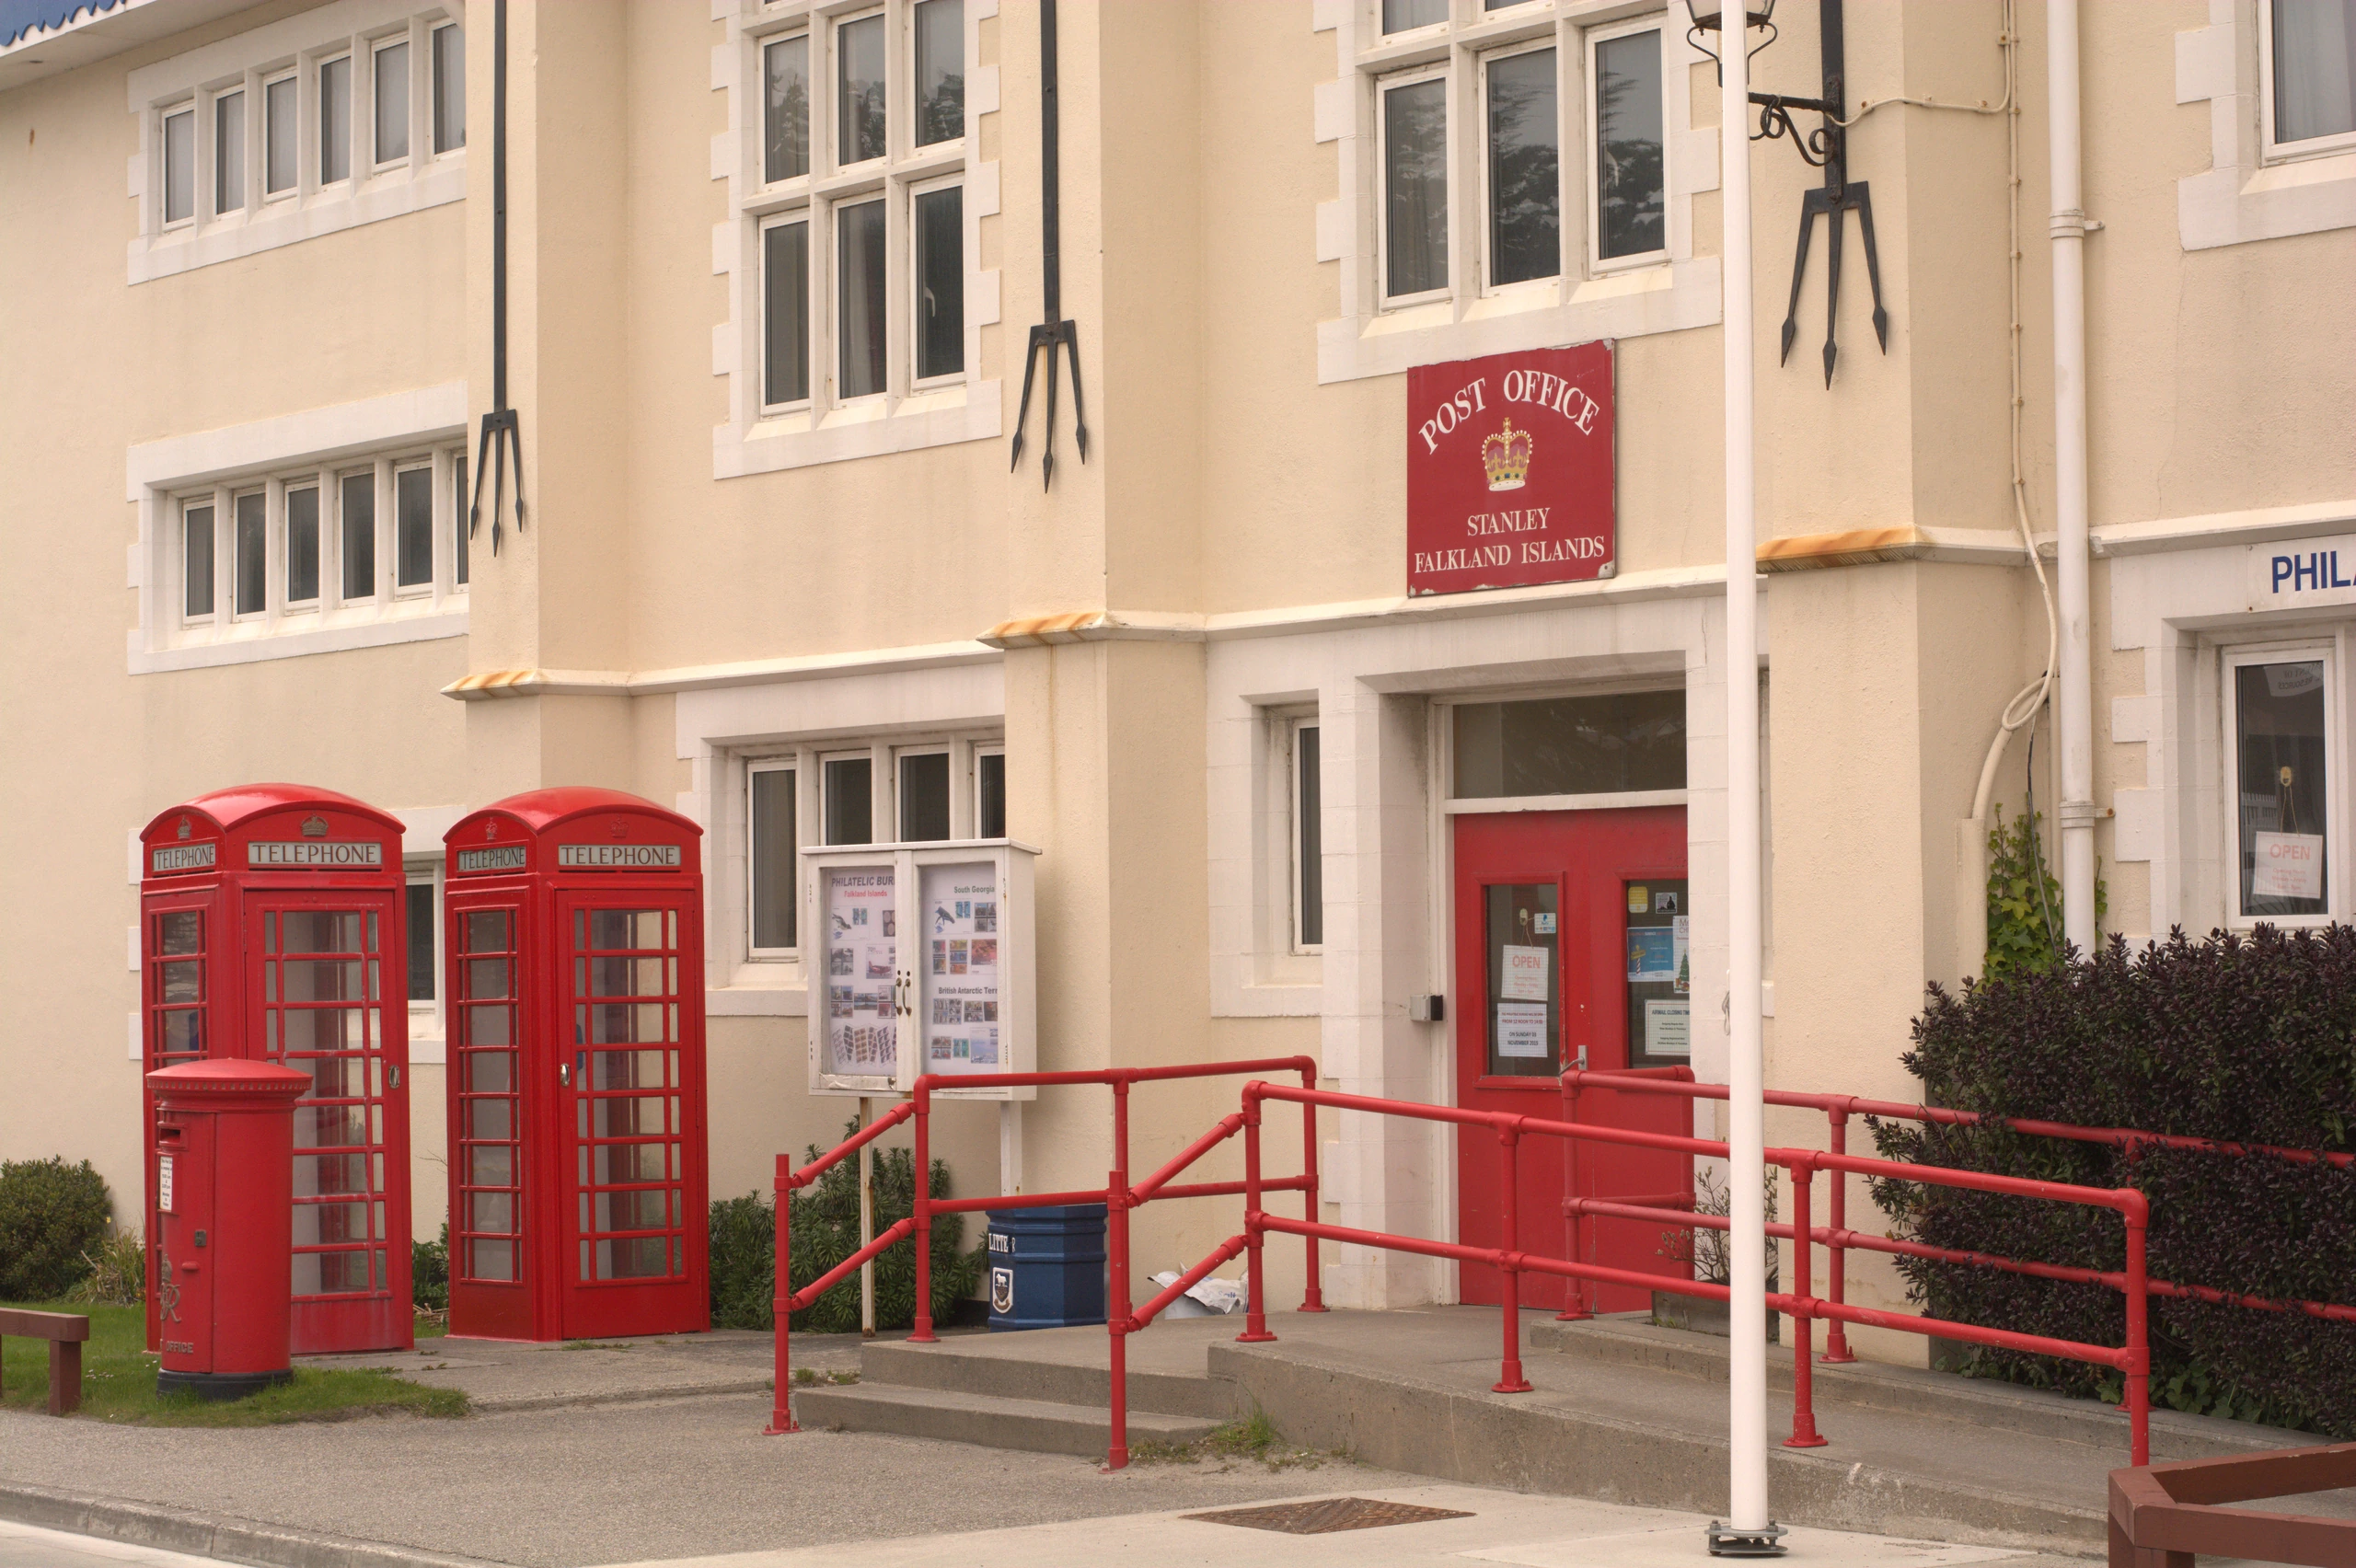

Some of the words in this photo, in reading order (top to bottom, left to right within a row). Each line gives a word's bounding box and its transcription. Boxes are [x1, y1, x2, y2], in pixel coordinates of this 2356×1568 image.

[1418, 377, 1486, 455] POST
[1503, 370, 1600, 435] OFFICE
[1467, 508, 1551, 536] STANLEY
[1415, 544, 1511, 573] FALKLAND
[1521, 536, 1604, 564] ISLANDS
[2272, 550, 2356, 594] PHIL
[156, 846, 214, 870] TELEPHONE
[252, 845, 376, 863] TELEPHONE
[461, 847, 525, 870] TELEPHONE
[561, 847, 675, 864] TELEPHONE
[2269, 844, 2310, 860] OPEN
[831, 876, 874, 887] PHILATELIC
[876, 875, 895, 885] BUR
[971, 885, 995, 894] Georgia
[1512, 954, 1541, 969] OPEN
[988, 1233, 1016, 1252] LITTER
[166, 1340, 194, 1354] OFFICE
